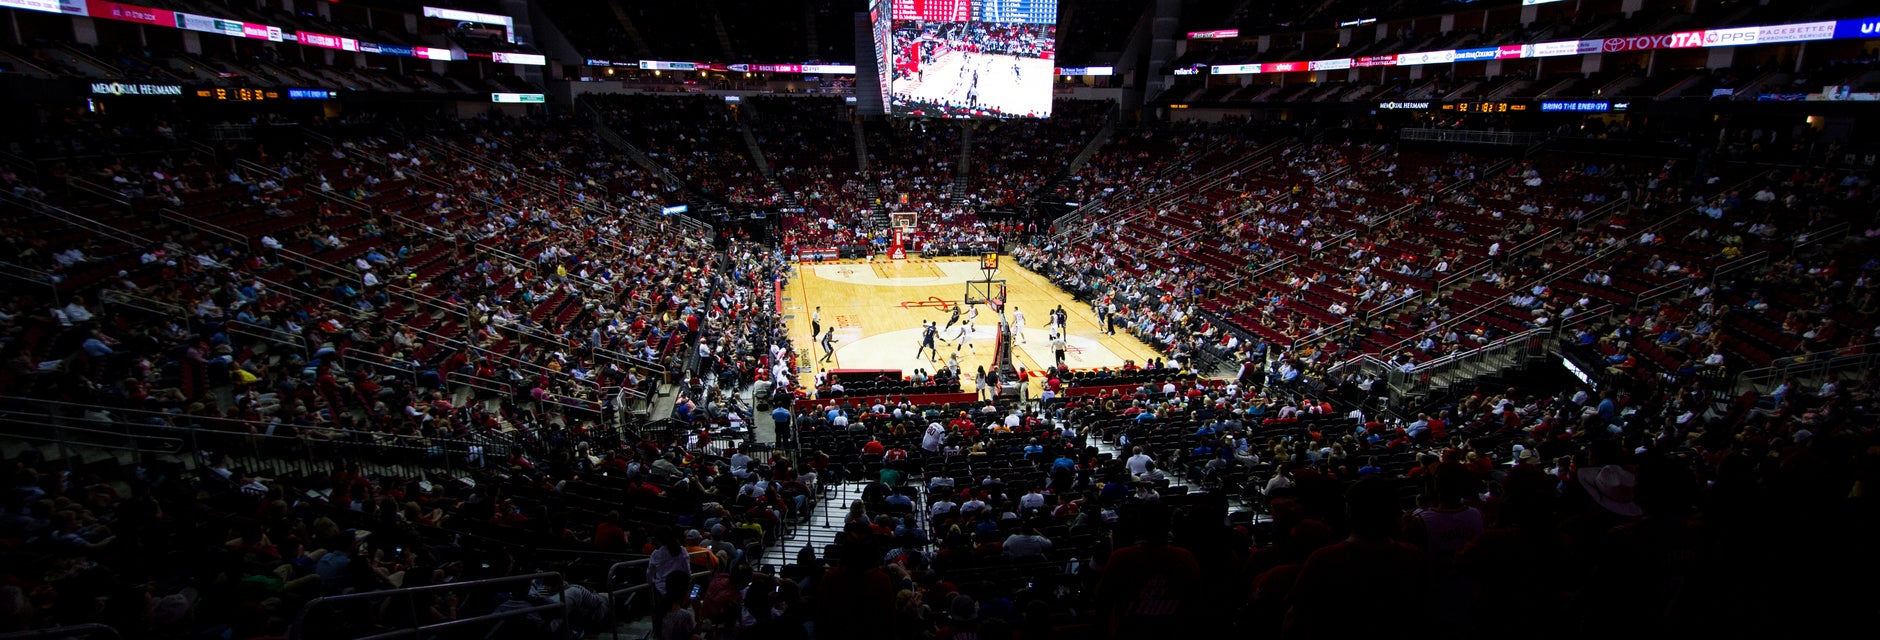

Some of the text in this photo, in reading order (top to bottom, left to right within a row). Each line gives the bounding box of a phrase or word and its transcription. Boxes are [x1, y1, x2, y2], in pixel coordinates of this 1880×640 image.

[1759, 25, 1833, 35] PACESETTER
[1626, 32, 1703, 49] TOYOTA
[1720, 31, 1755, 42] PPS
[1174, 67, 1193, 75] reliant
[91, 82, 182, 95] MEMORIAL HERMANN
[1379, 101, 1404, 110] MEMORIAL
[1459, 103, 1468, 112] 52
